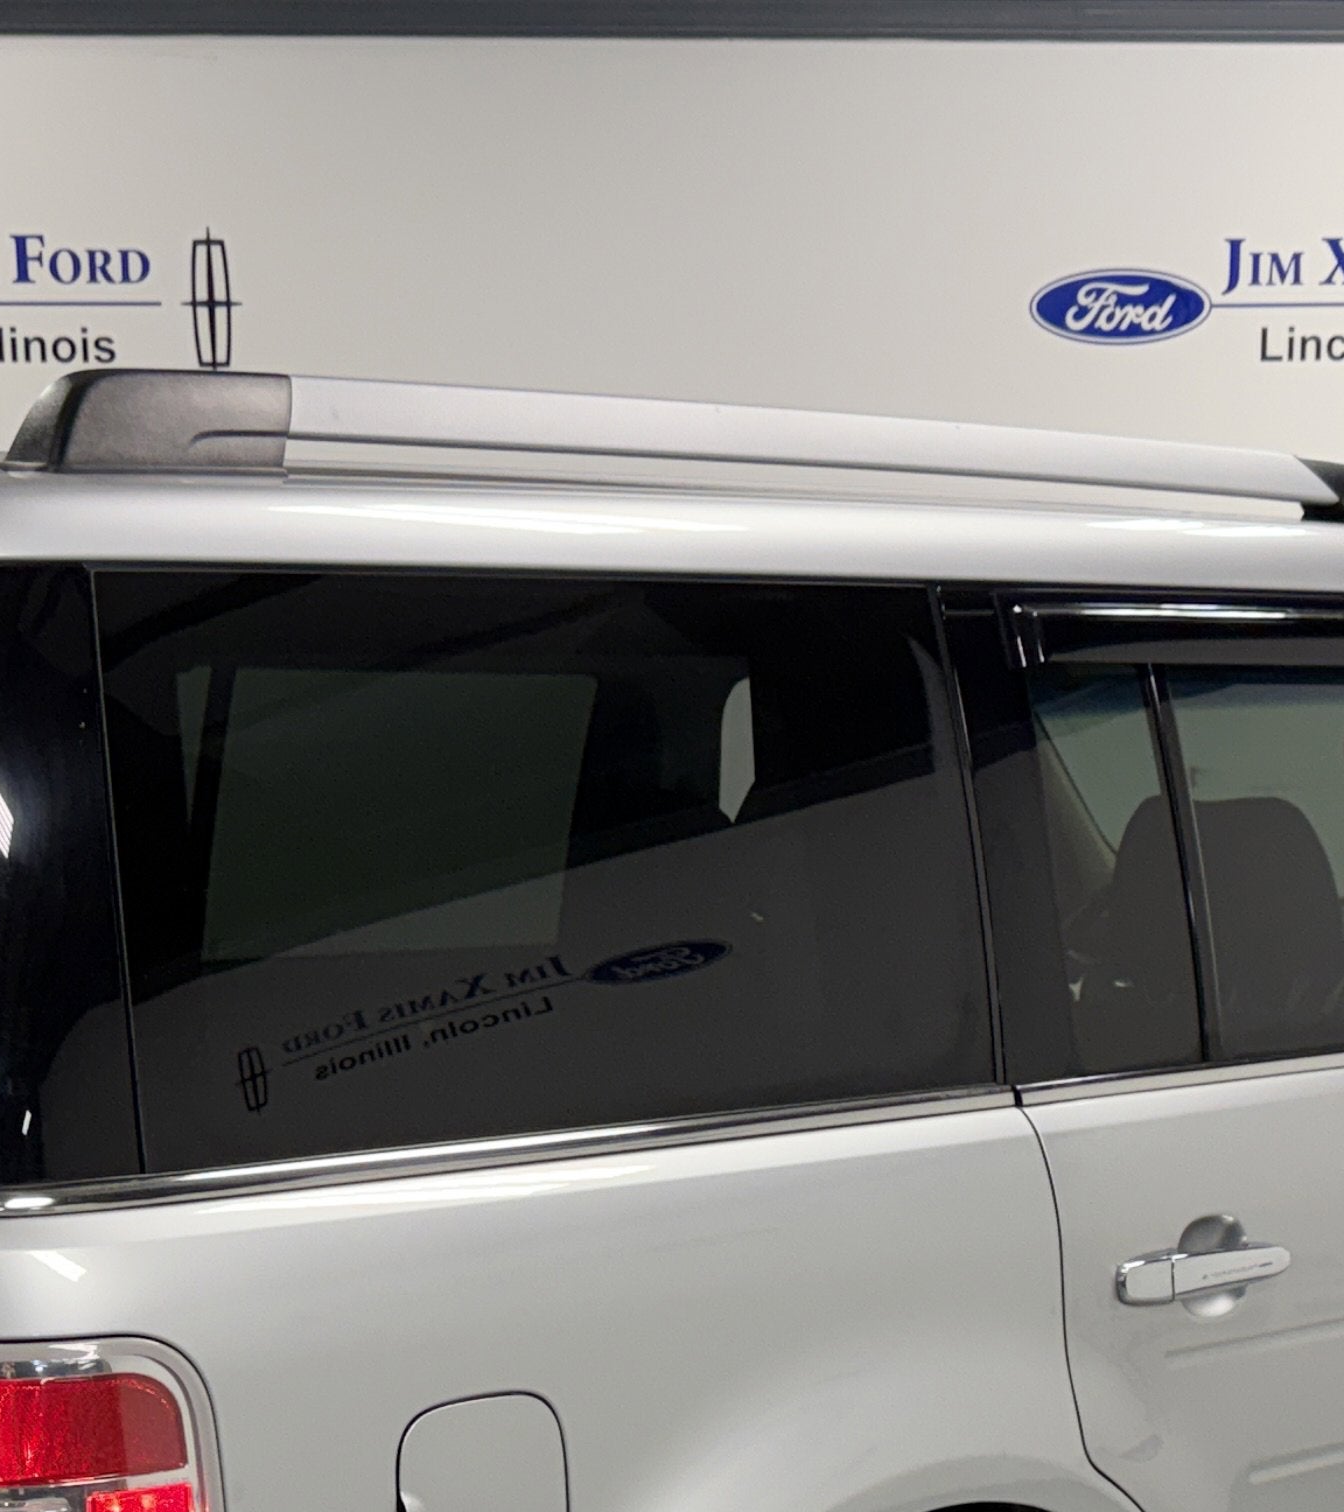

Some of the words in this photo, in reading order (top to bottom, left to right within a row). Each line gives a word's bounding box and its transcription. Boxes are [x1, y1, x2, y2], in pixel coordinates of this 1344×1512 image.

[10, 233, 152, 286] FORD
[1221, 238, 1304, 295] JIM
[1065, 281, 1177, 333] Ford
